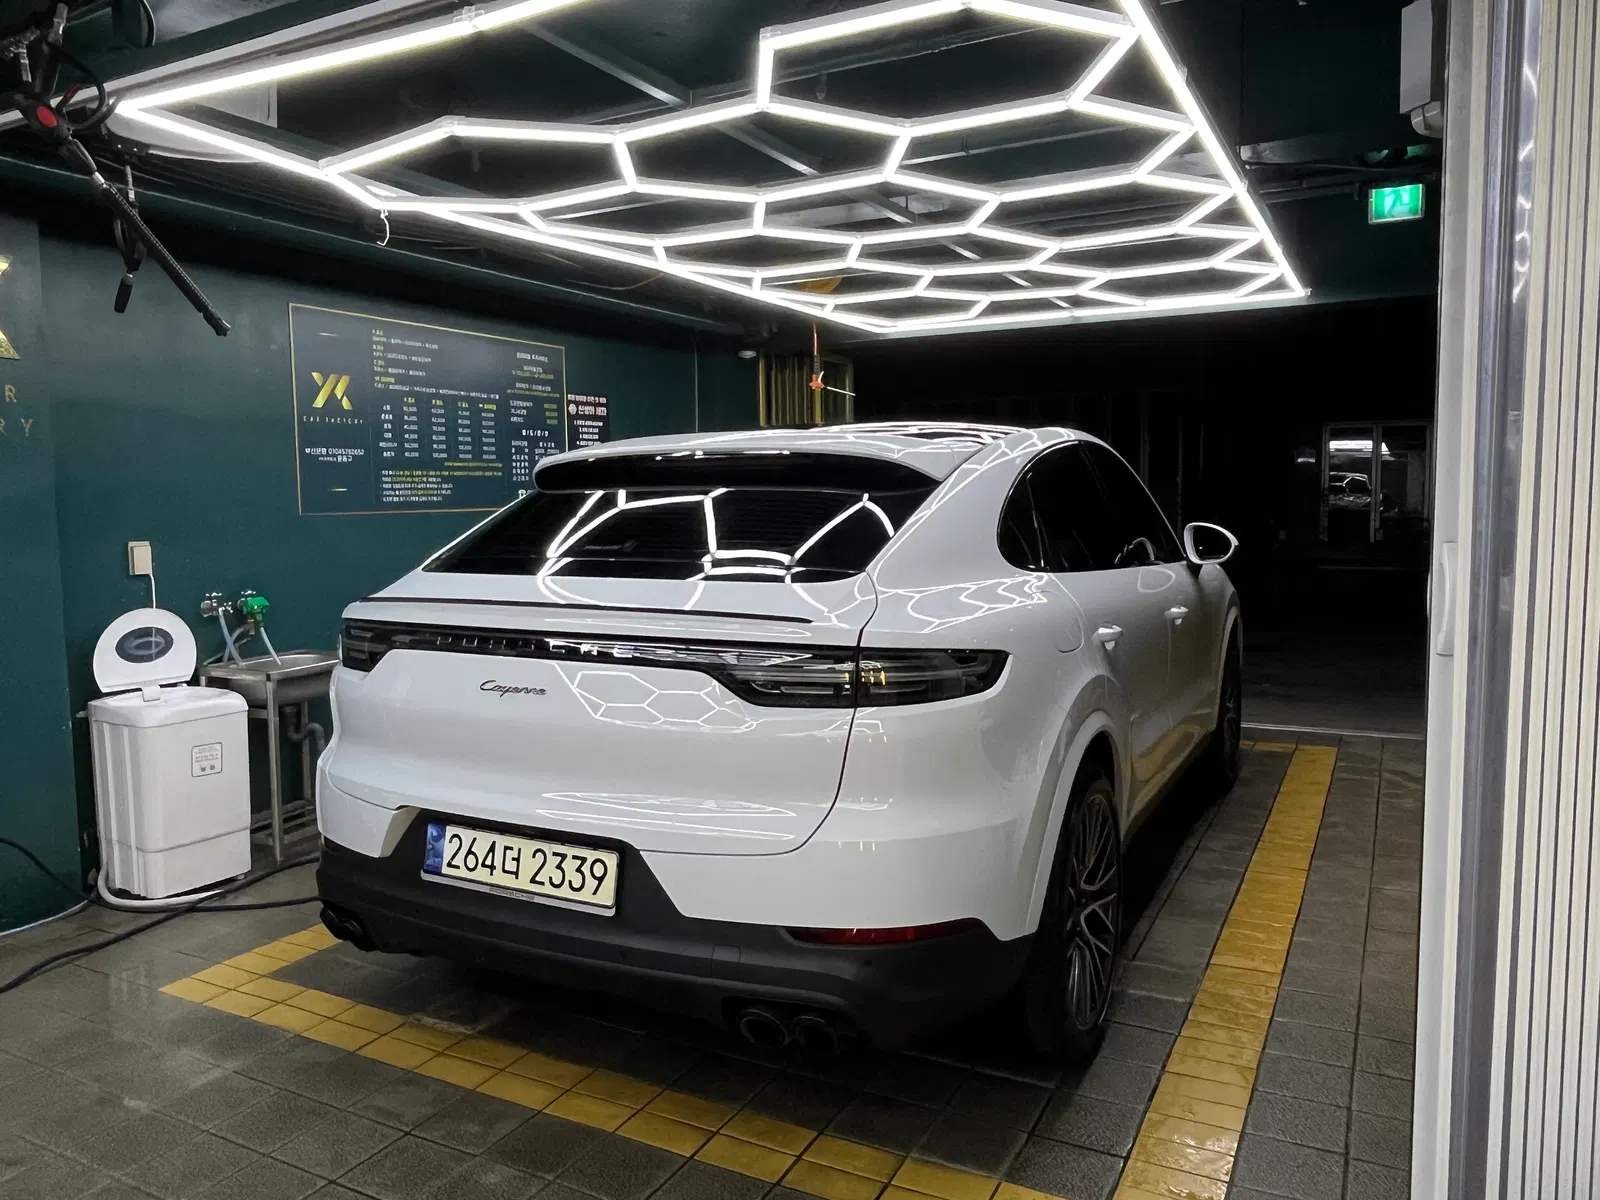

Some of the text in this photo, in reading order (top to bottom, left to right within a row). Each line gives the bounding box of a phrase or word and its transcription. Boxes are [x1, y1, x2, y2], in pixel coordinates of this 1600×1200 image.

[479, 679, 547, 698] Cayenne
[446, 833, 608, 896] 264더 2339
